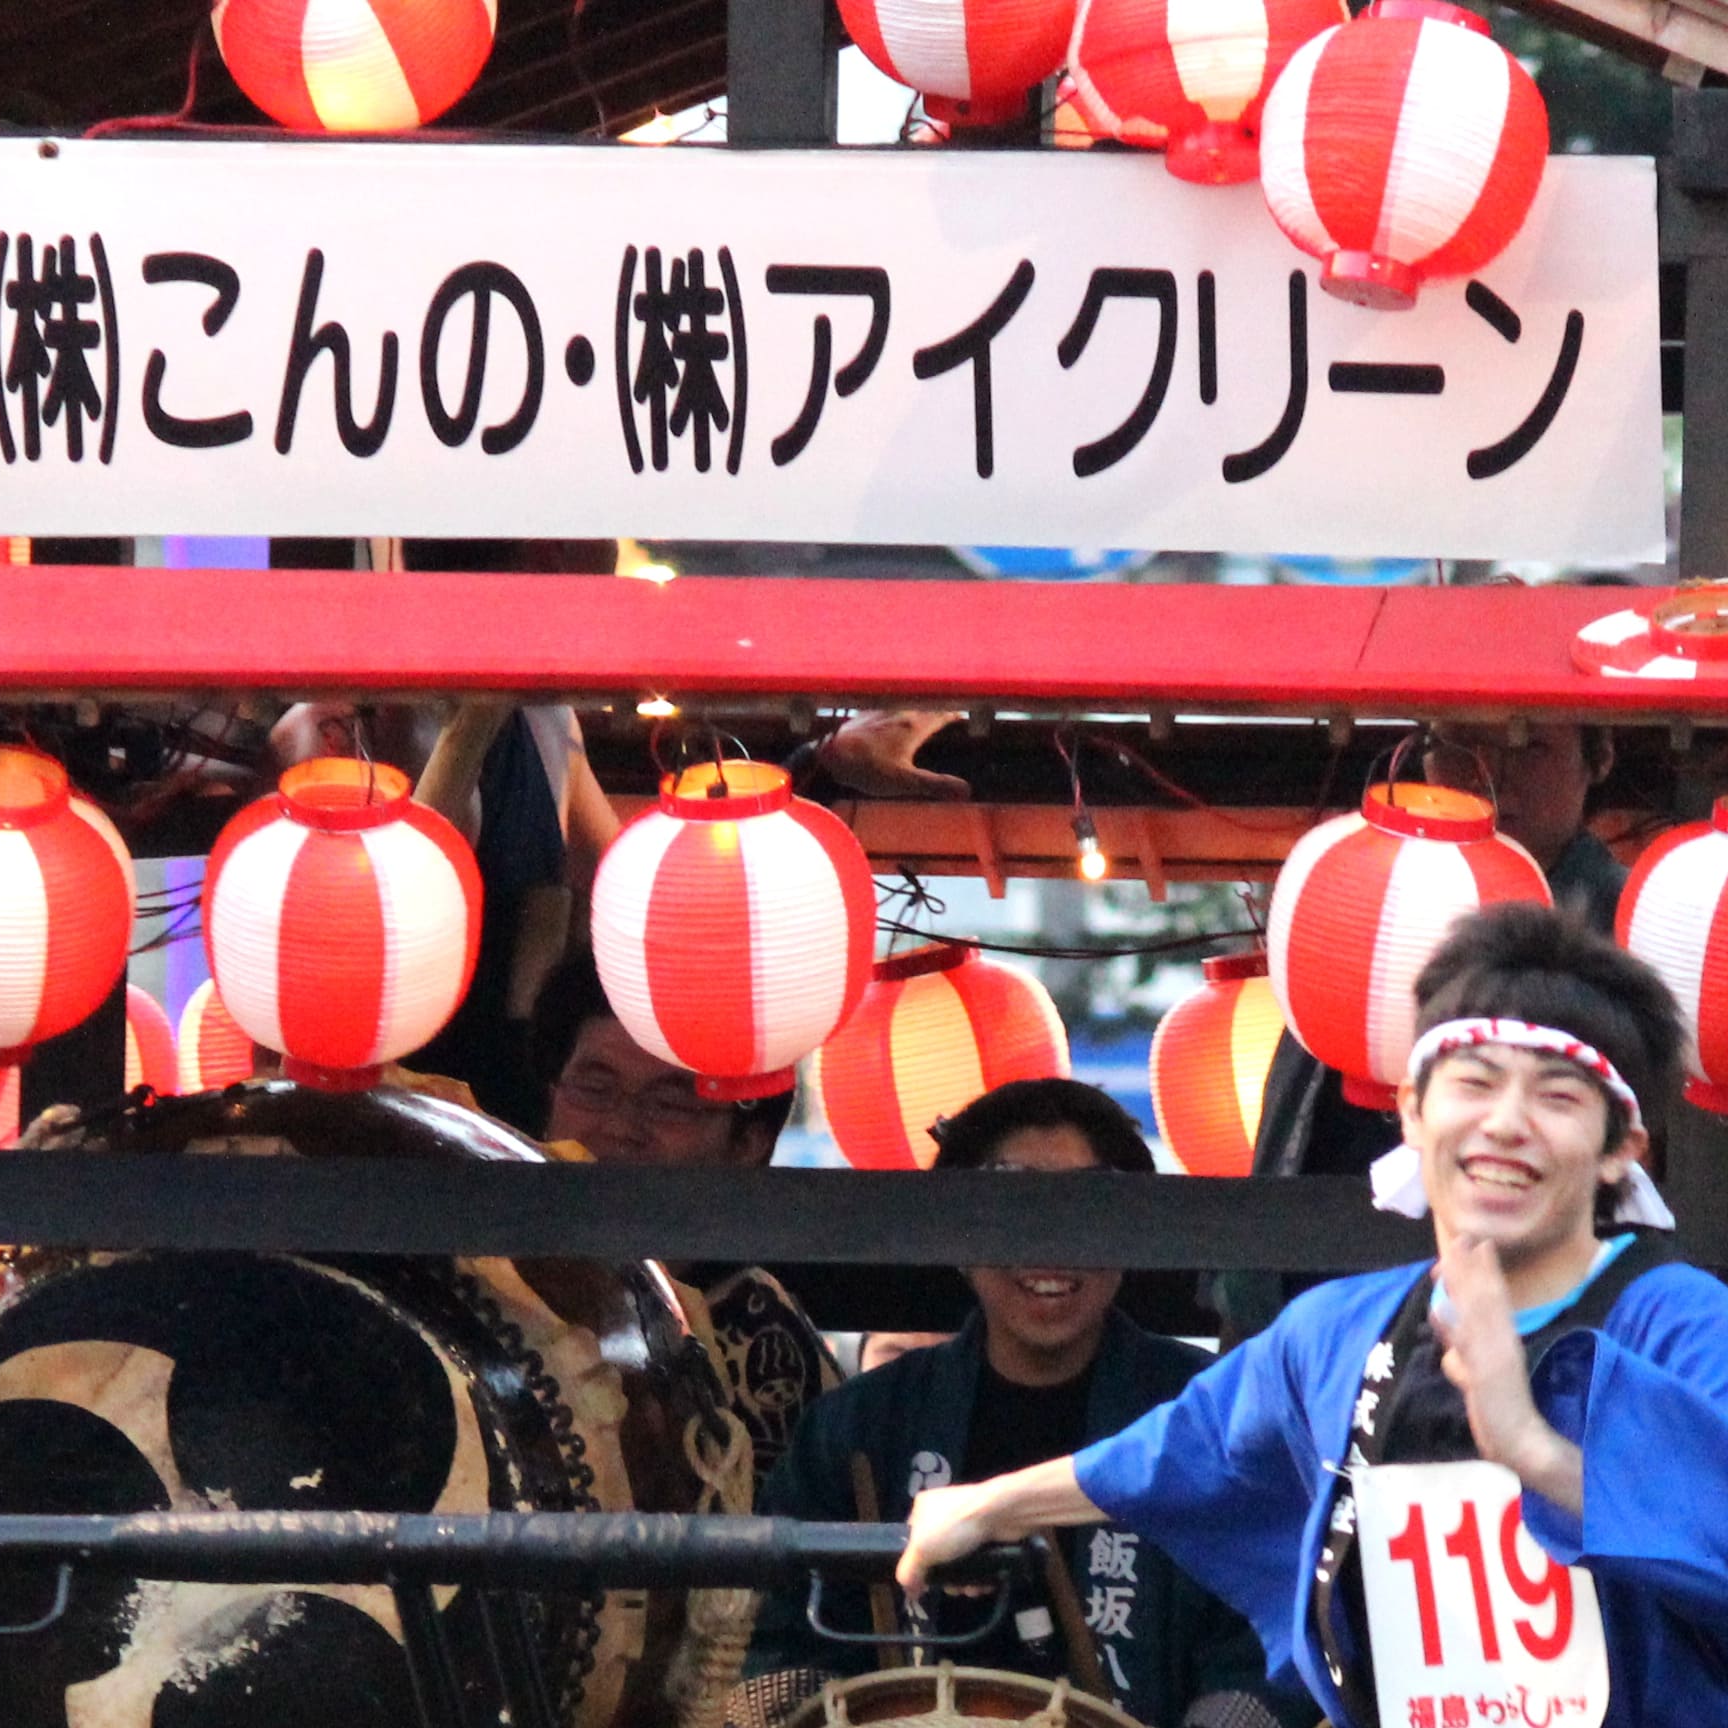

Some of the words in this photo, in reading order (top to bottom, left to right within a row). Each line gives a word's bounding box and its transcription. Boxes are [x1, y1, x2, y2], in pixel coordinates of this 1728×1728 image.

[1084, 1528, 1141, 1713] 飯坂八
[1387, 1494, 1575, 1667] 119
